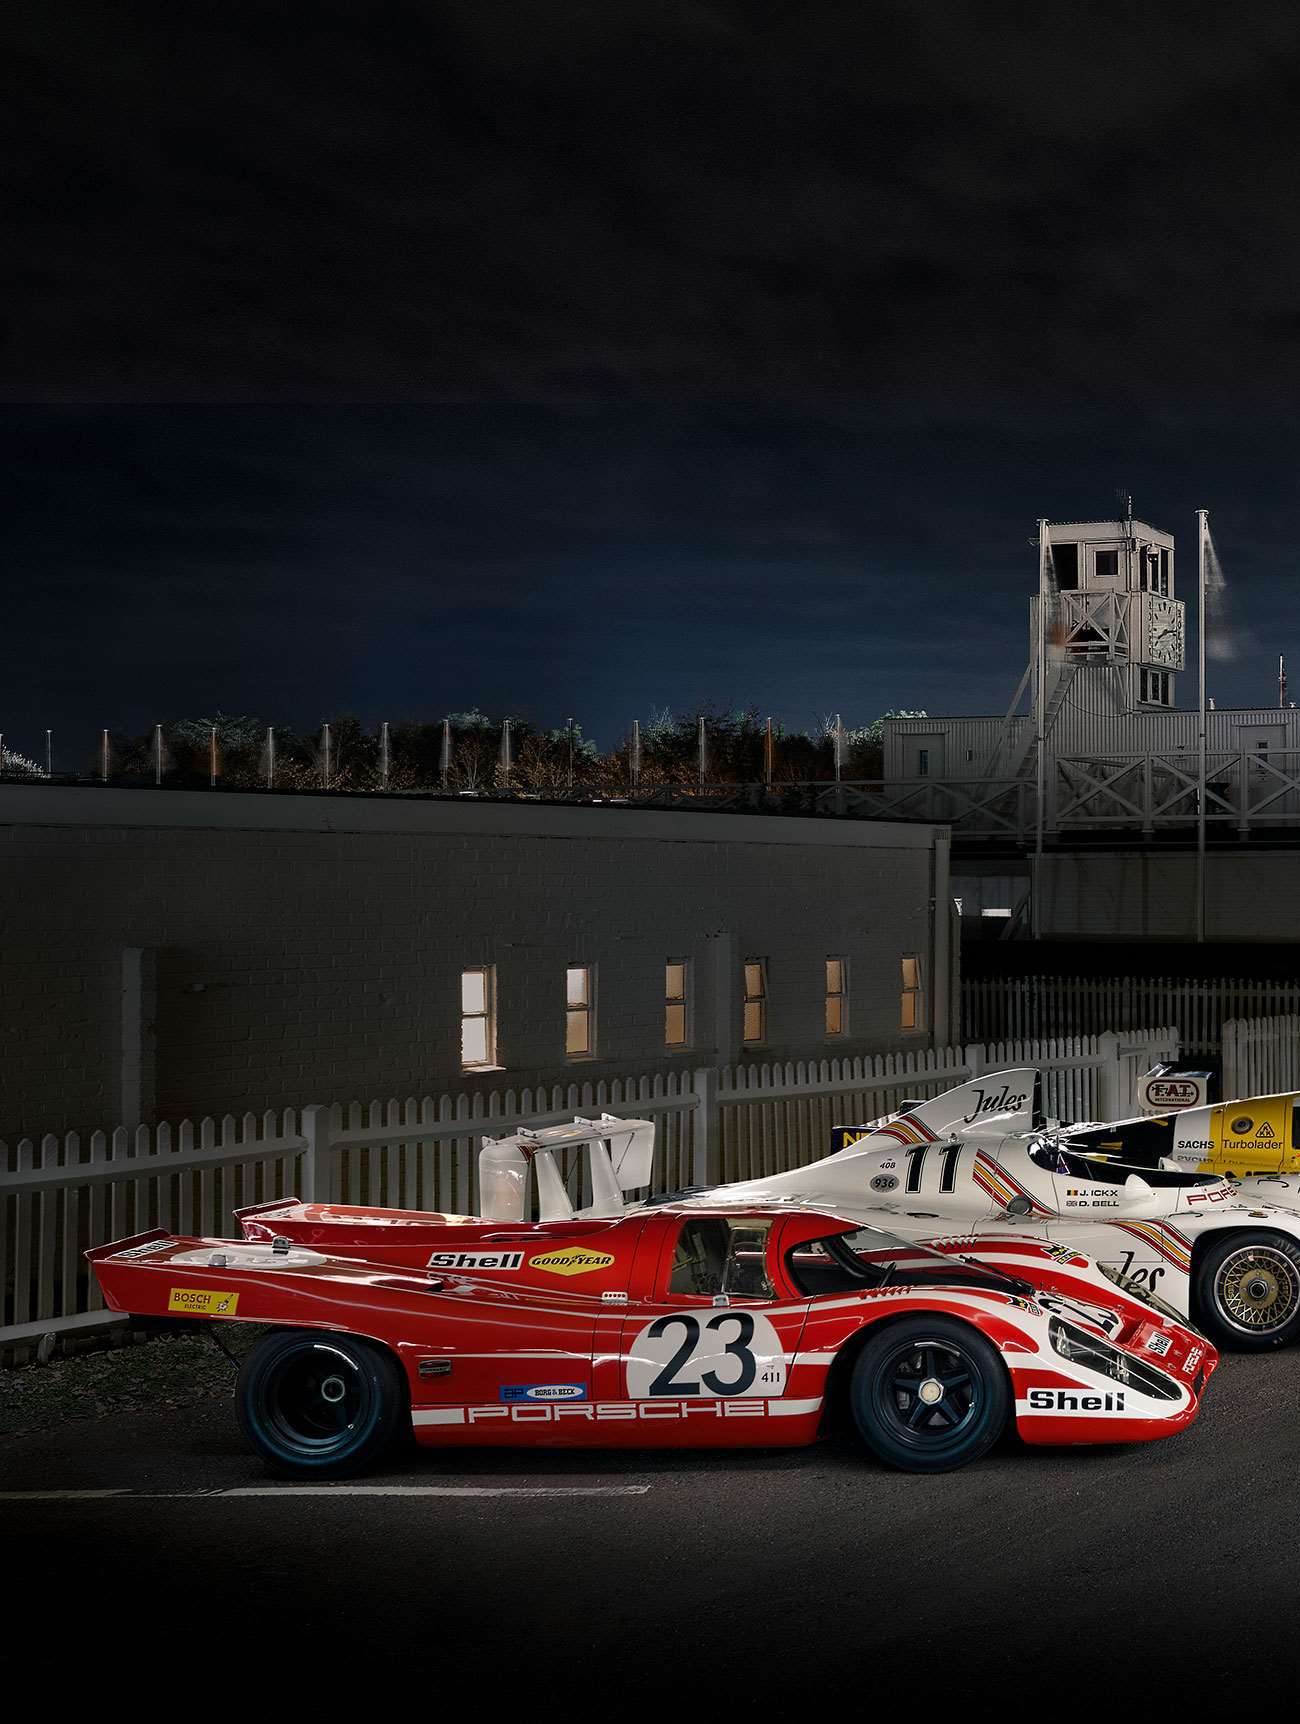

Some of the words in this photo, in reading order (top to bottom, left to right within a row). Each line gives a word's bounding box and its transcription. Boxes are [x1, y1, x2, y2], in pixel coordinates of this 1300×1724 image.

[964, 1086, 1027, 1123] Jules
[1177, 1141, 1214, 1149] SACHS
[1223, 1139, 1283, 1149] Turbolader
[905, 1143, 965, 1193] 11
[874, 1177, 895, 1188] 936
[1091, 1189, 1118, 1197] ICKX
[430, 1253, 521, 1268] Shell
[174, 1292, 212, 1304] BOSCH
[1148, 1332, 1171, 1356] Shell
[647, 1312, 756, 1396] 23
[761, 1372, 780, 1383] 411
[535, 1387, 551, 1396] BORG
[558, 1387, 576, 1396] BECK
[1030, 1391, 1125, 1411] Shell
[468, 1401, 764, 1423] PORSCHE
